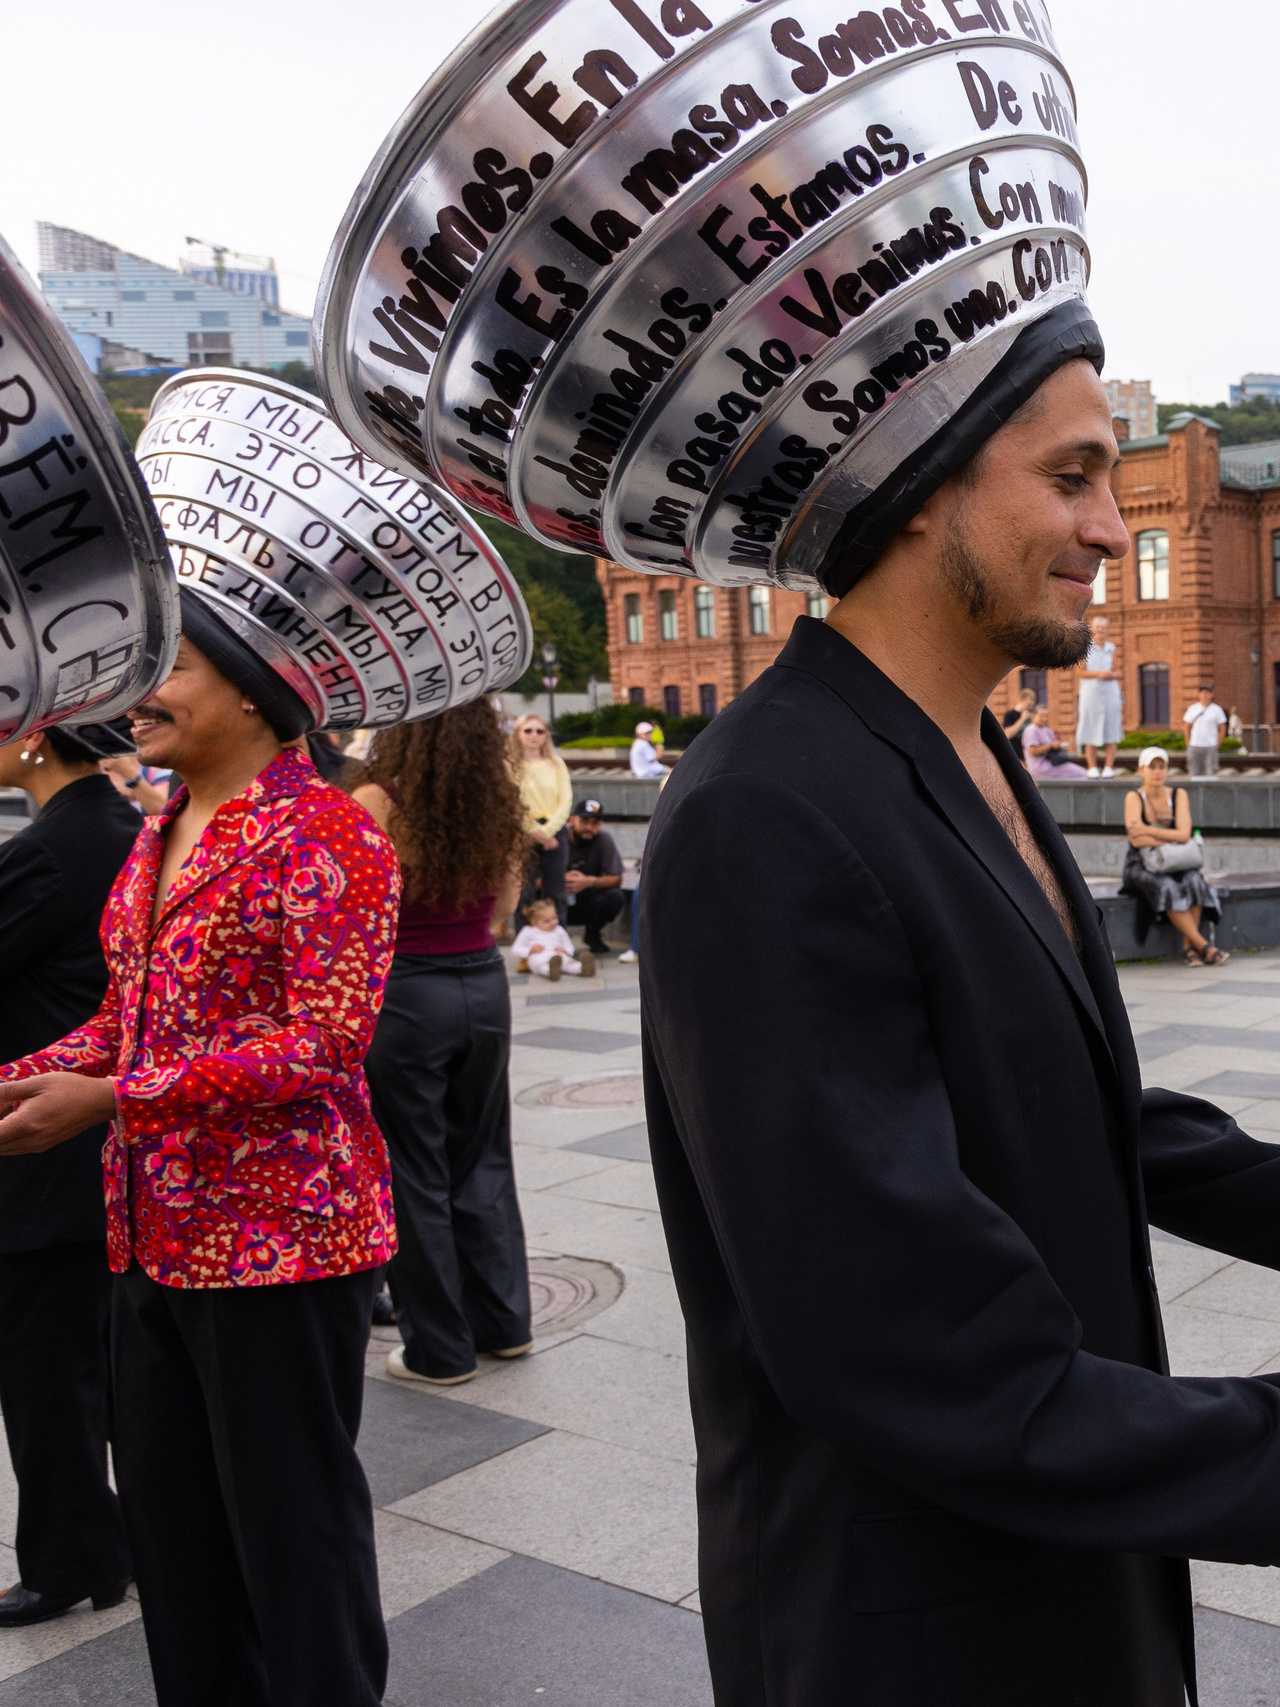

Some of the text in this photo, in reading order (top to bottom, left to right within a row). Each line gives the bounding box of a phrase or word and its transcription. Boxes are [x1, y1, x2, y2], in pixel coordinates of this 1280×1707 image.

[369, 148, 554, 375] Vivimos.
[507, 49, 638, 149] En
[495, 264, 590, 343] Es
[550, 208, 642, 267] la
[620, 83, 789, 216] masa.
[770, 0, 951, 95] Somos.
[533, 286, 728, 500] dominados.
[698, 123, 927, 285] Estamos.
[957, 61, 1023, 131] De
[624, 495, 695, 547] Con
[666, 338, 814, 496] pasado.
[779, 206, 981, 338] Venimos.
[968, 156, 1043, 230] Con
[802, 317, 951, 436] Somos
[1012, 236, 1069, 301] Con
[205, 468, 277, 518] МЫ
[300, 520, 429, 658] ОТТУДА.
[414, 664, 447, 706] МЫ
[236, 432, 321, 489] ЭТО
[342, 497, 460, 627] ГОЛОД.
[450, 630, 484, 686] ЭТО
[245, 396, 323, 450] МЫ.
[469, 579, 503, 613] В
[324, 604, 391, 675] МЫ.
